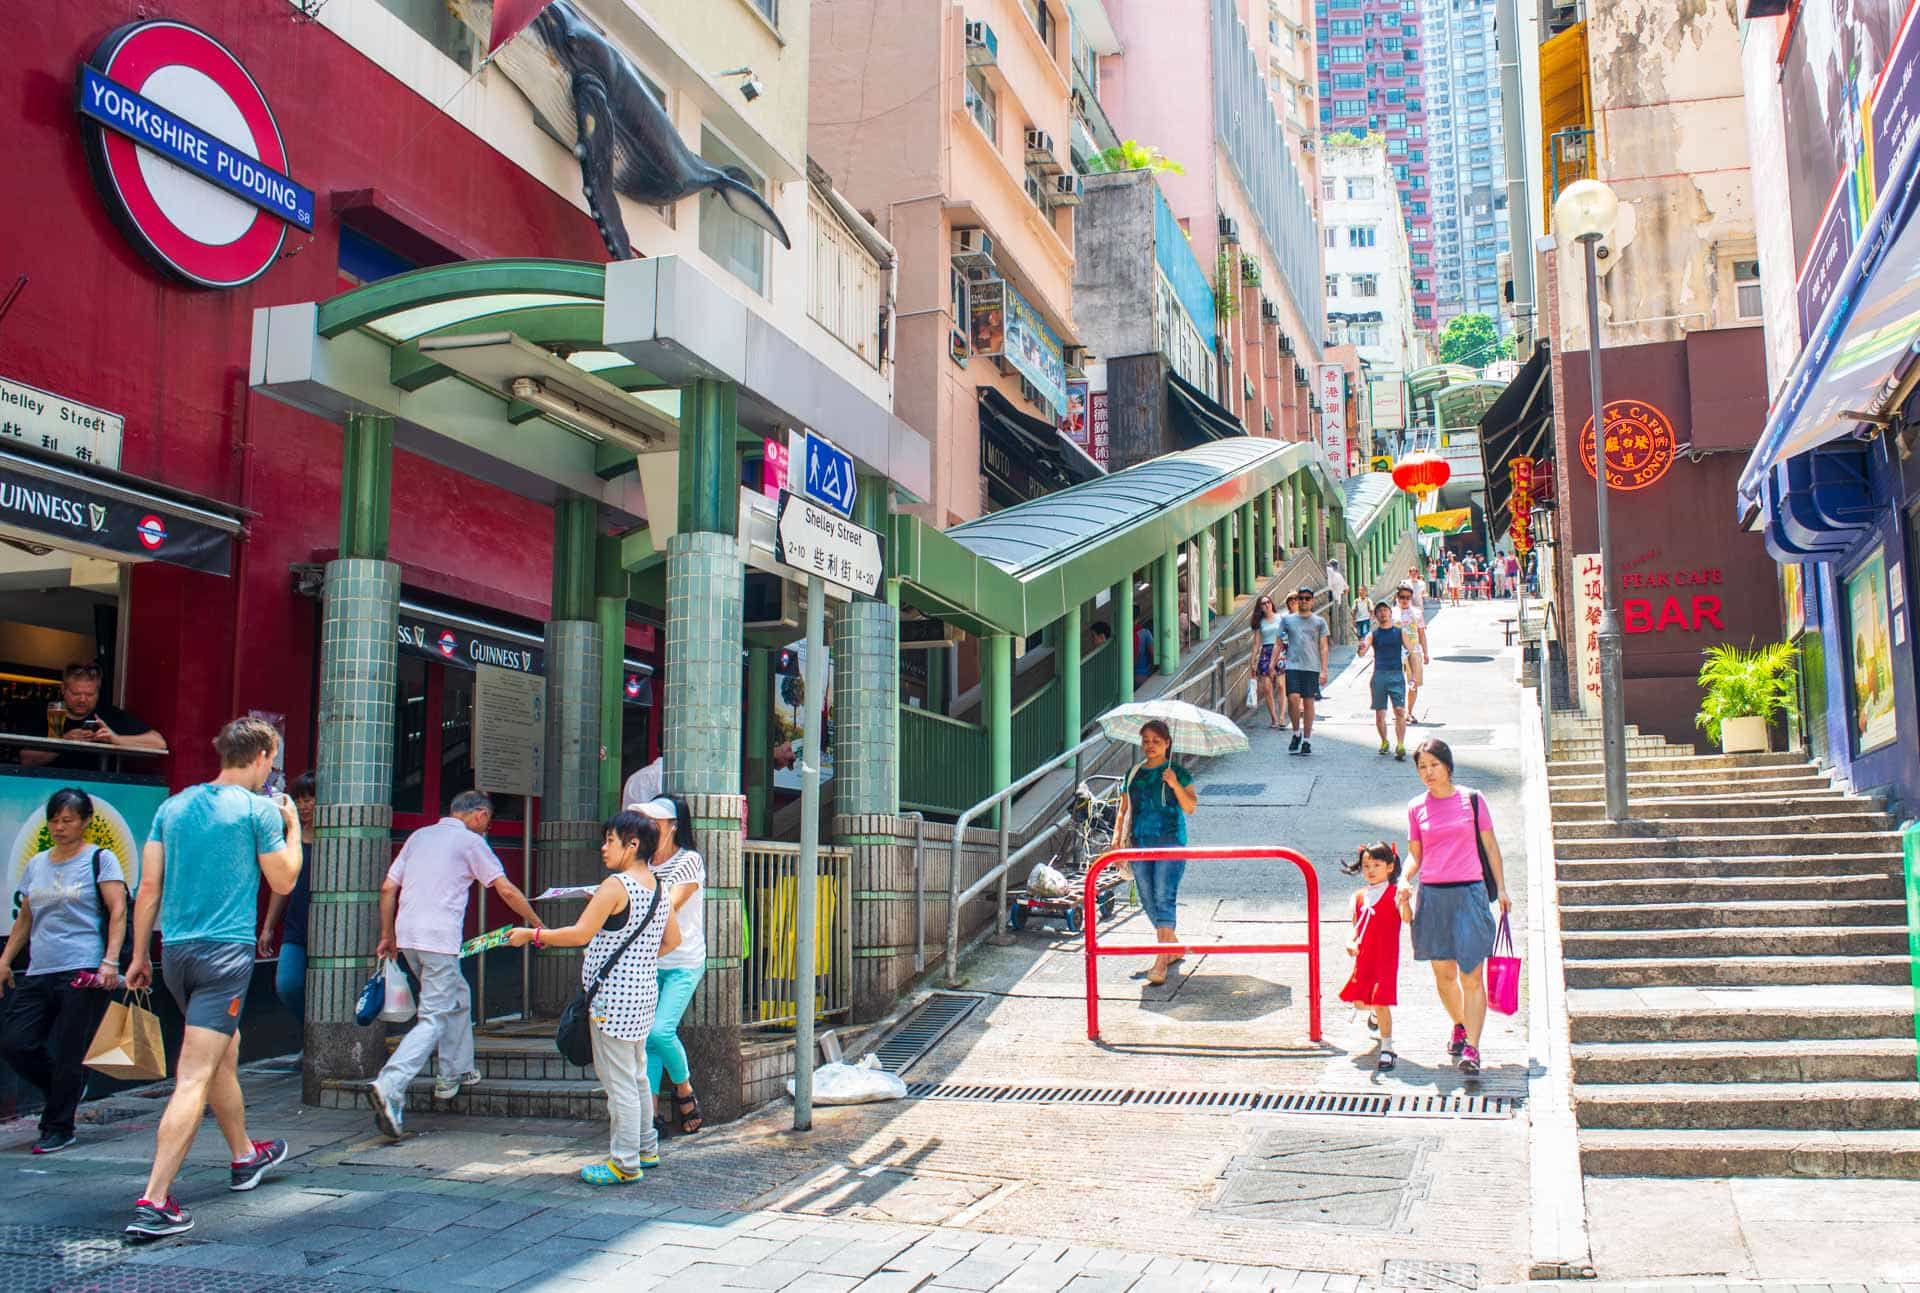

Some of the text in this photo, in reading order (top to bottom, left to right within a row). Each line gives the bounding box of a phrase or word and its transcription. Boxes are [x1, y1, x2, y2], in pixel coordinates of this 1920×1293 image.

[91, 79, 297, 211] YORKSHIRE PUDDING
[296, 208, 311, 225] S8
[0, 385, 105, 433] helley Street
[1632, 450, 1667, 484] KONG
[806, 507, 862, 547] Shelley Street
[814, 546, 852, 582] 些利街
[1622, 571, 1670, 589] PEAK
[1623, 594, 1726, 634] BAR
[470, 639, 520, 669] GUINNESS
